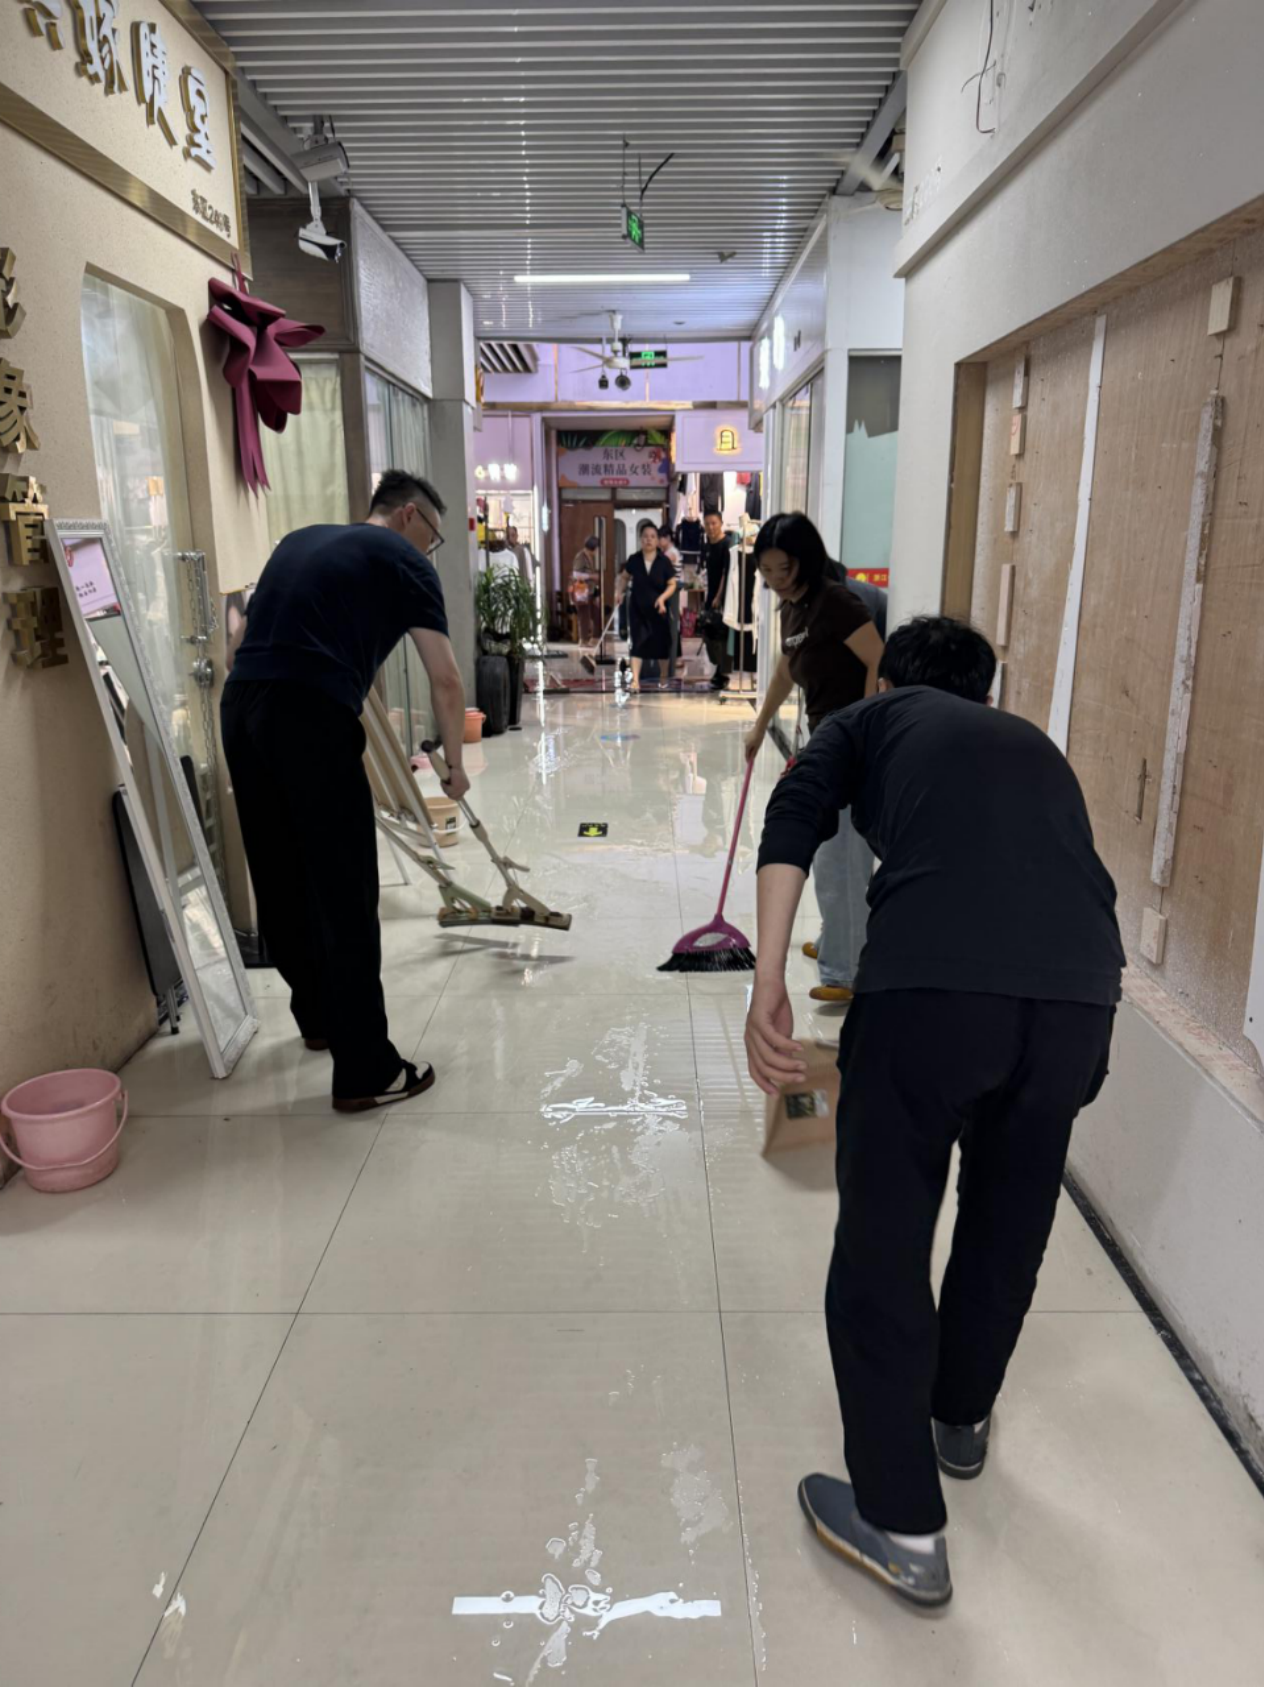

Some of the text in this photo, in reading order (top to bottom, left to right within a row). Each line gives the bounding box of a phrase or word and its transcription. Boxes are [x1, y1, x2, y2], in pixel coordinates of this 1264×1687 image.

[602, 448, 626, 461] 东区
[578, 463, 652, 476] 潮流精品女装
